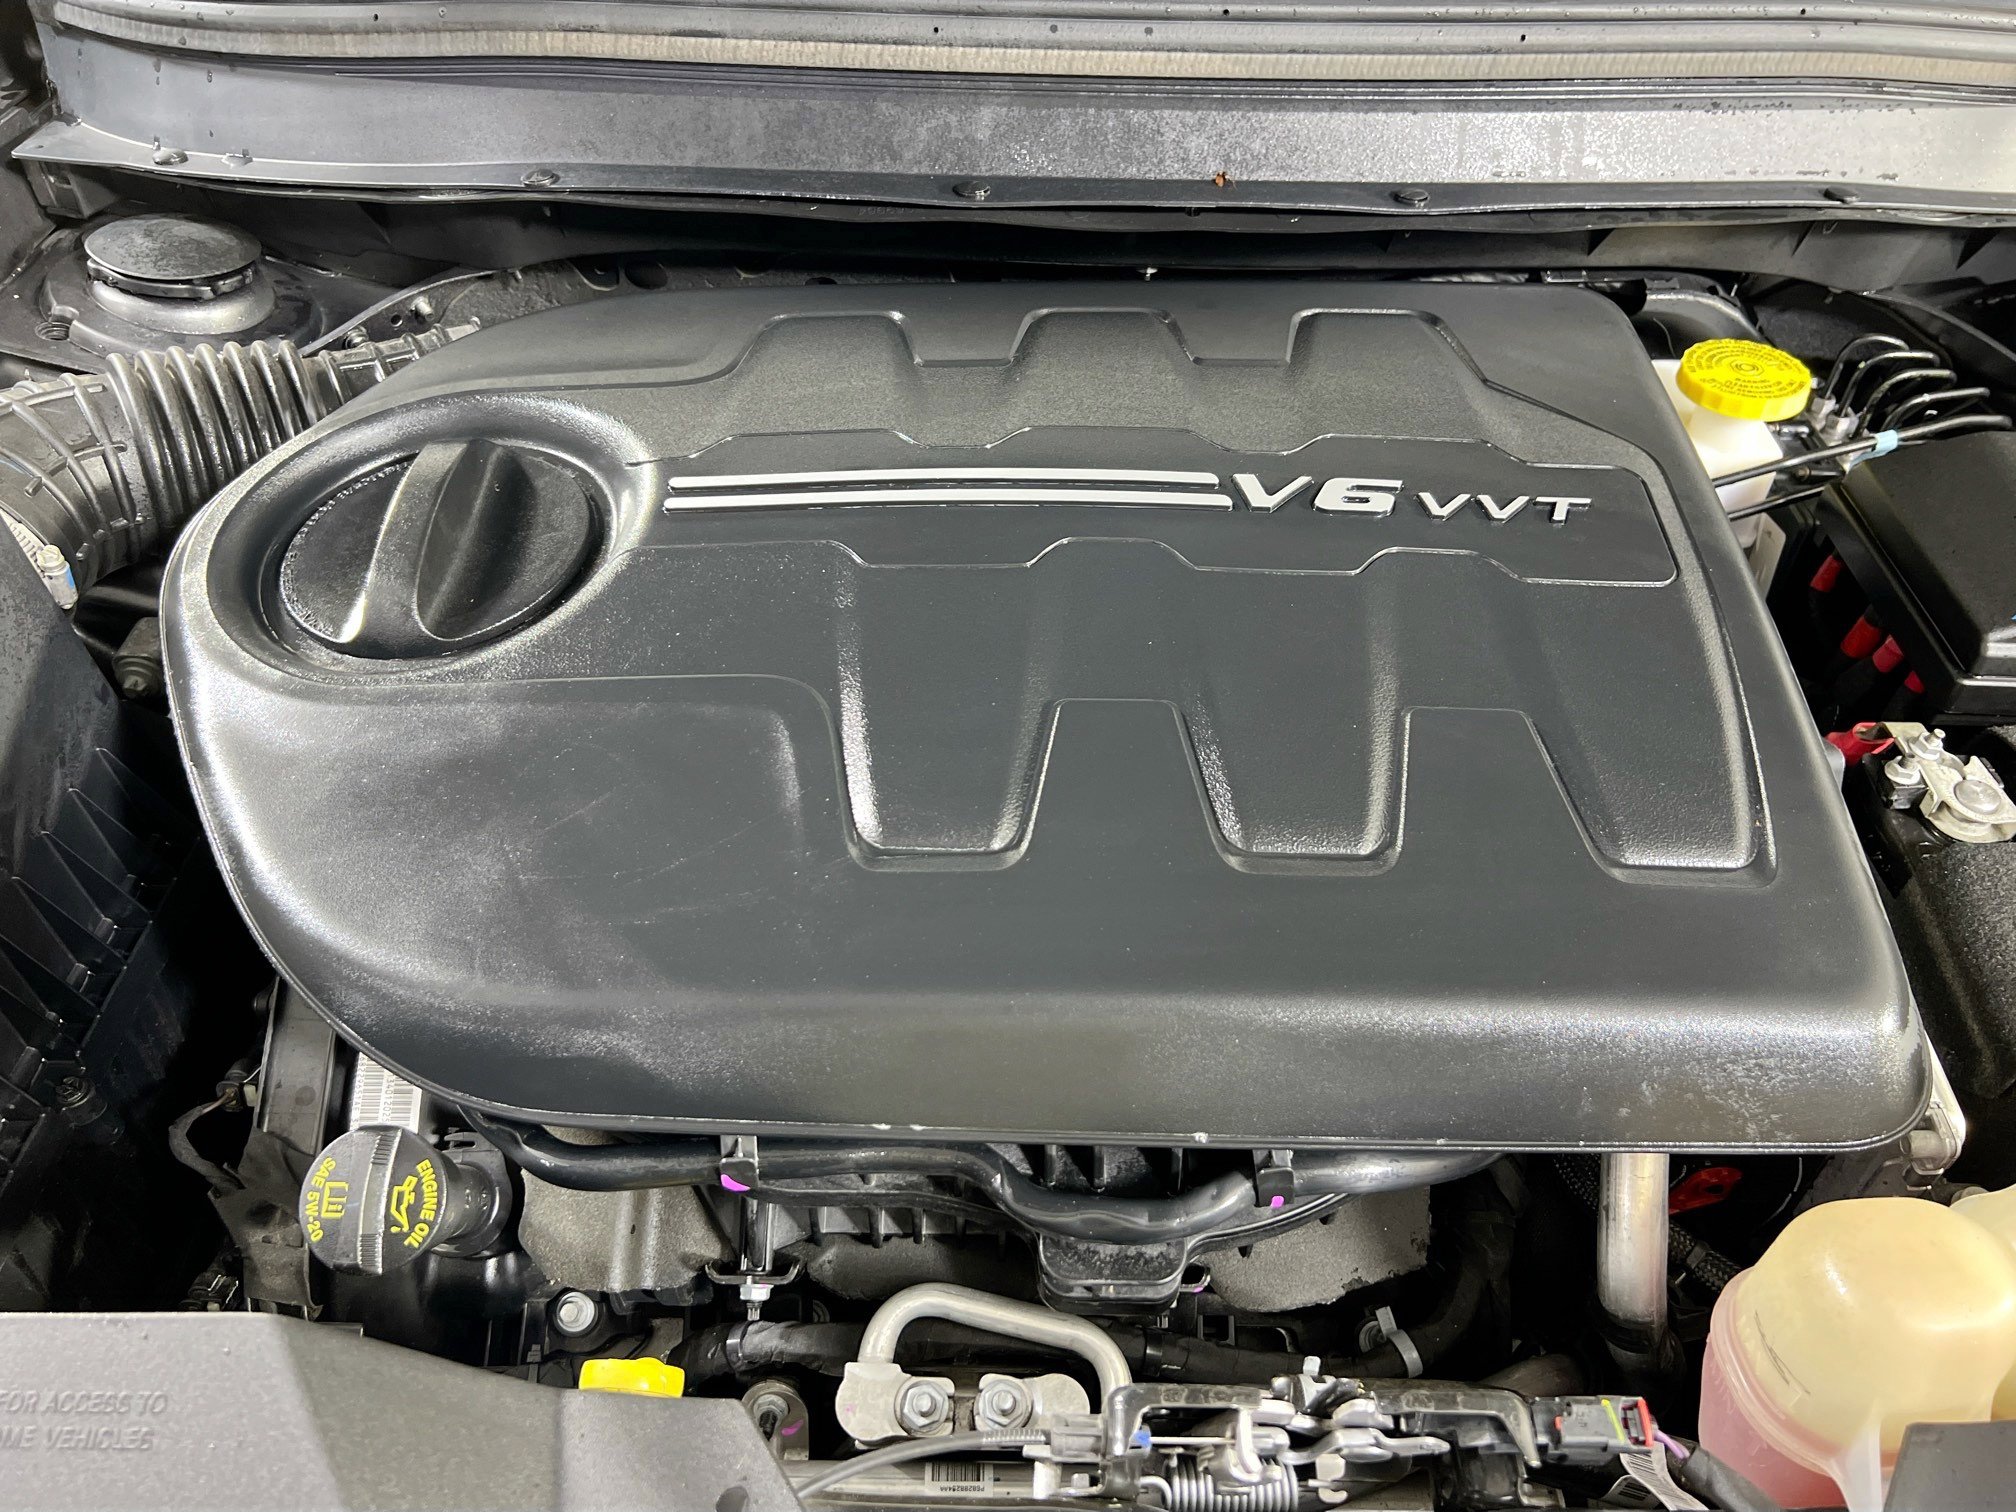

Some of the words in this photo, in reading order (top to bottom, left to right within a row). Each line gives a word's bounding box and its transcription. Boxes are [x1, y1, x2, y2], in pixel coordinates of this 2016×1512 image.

[1231, 473, 1405, 517] V6
[1414, 491, 1593, 525] VVT
[311, 1157, 336, 1188] SAE
[416, 1158, 438, 1221] ENGINE
[306, 1192, 324, 1243] 5W-20
[403, 1221, 430, 1249] OIL
[41, 1389, 132, 1414] ACCESS
[138, 1390, 169, 1415] TO
[45, 1426, 155, 1450] VEHICLES
